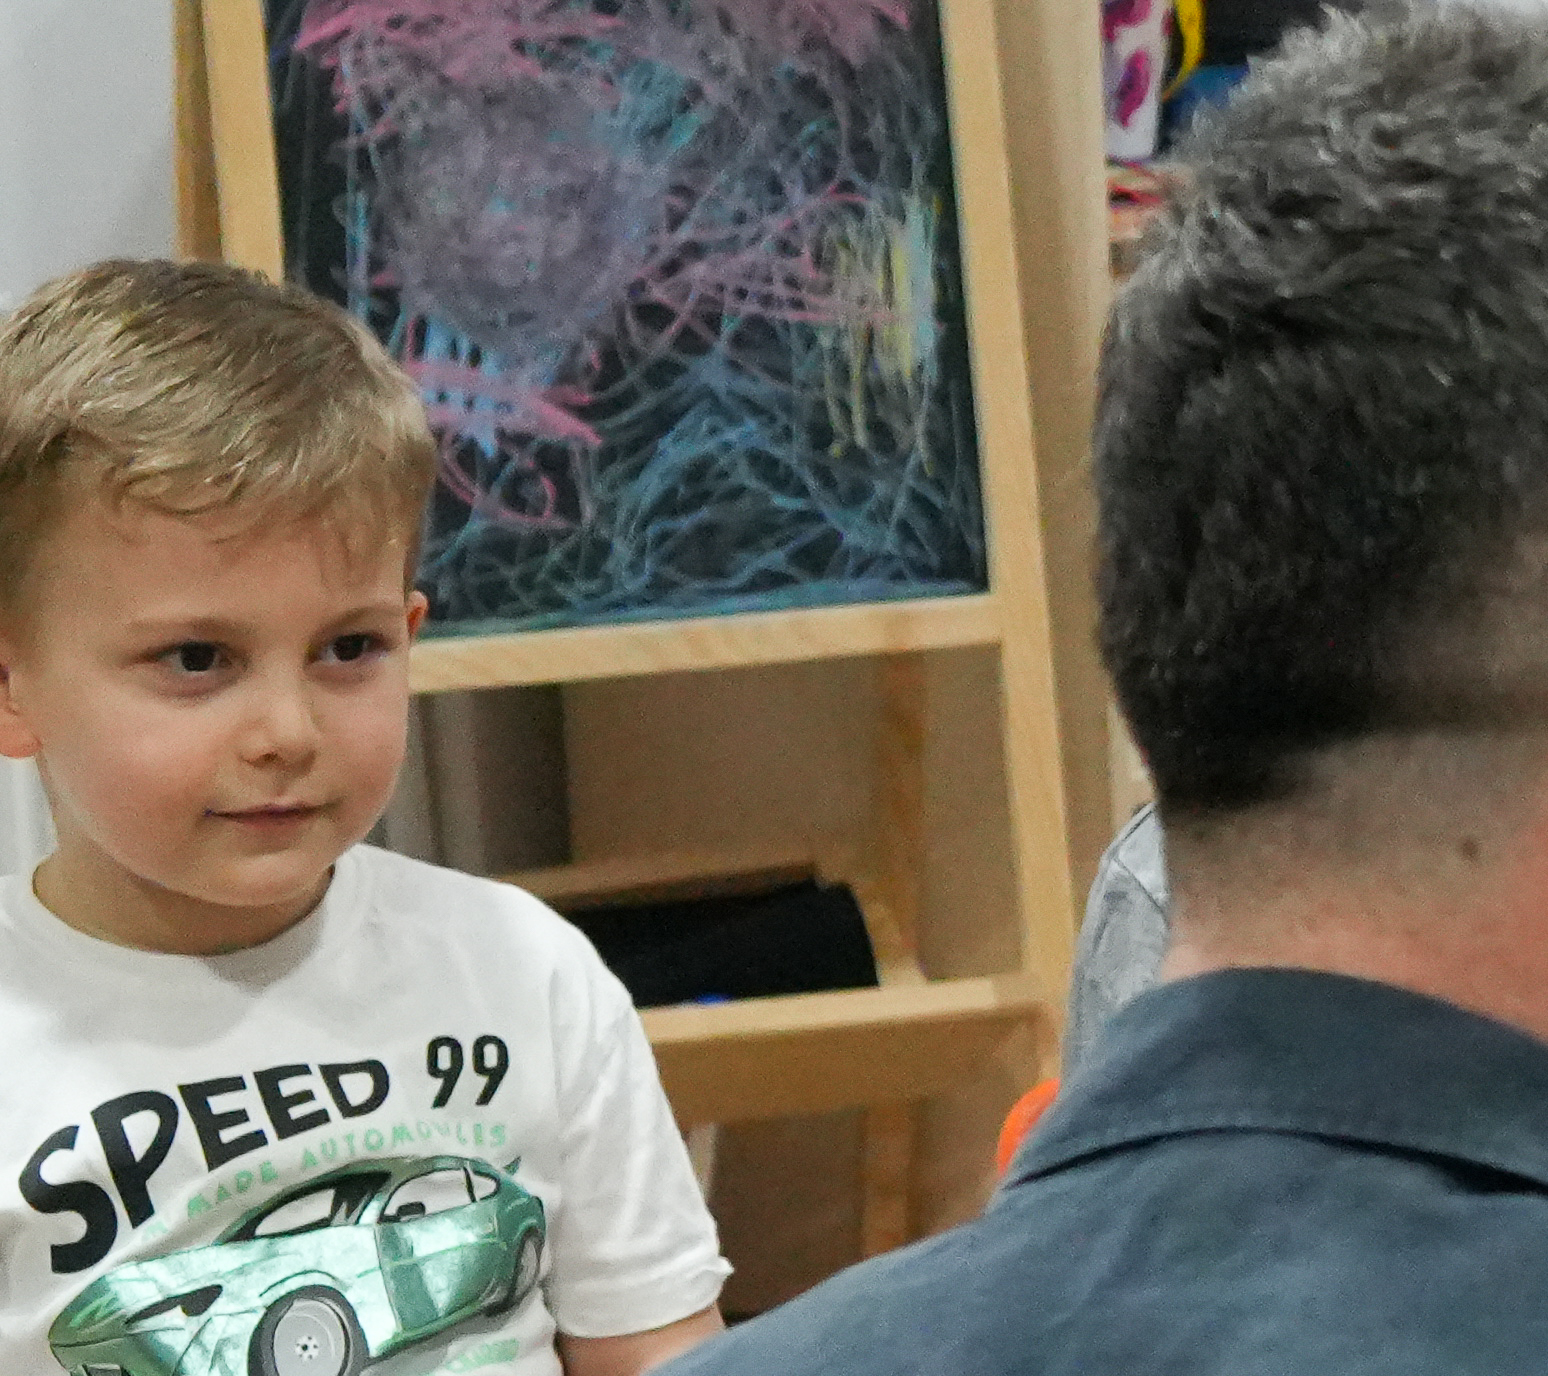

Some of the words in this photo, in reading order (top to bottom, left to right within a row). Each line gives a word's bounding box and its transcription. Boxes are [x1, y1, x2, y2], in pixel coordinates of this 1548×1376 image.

[18, 1059, 390, 1274] SPEED
[426, 1034, 510, 1109] 99
[187, 1160, 278, 1221] MADE
